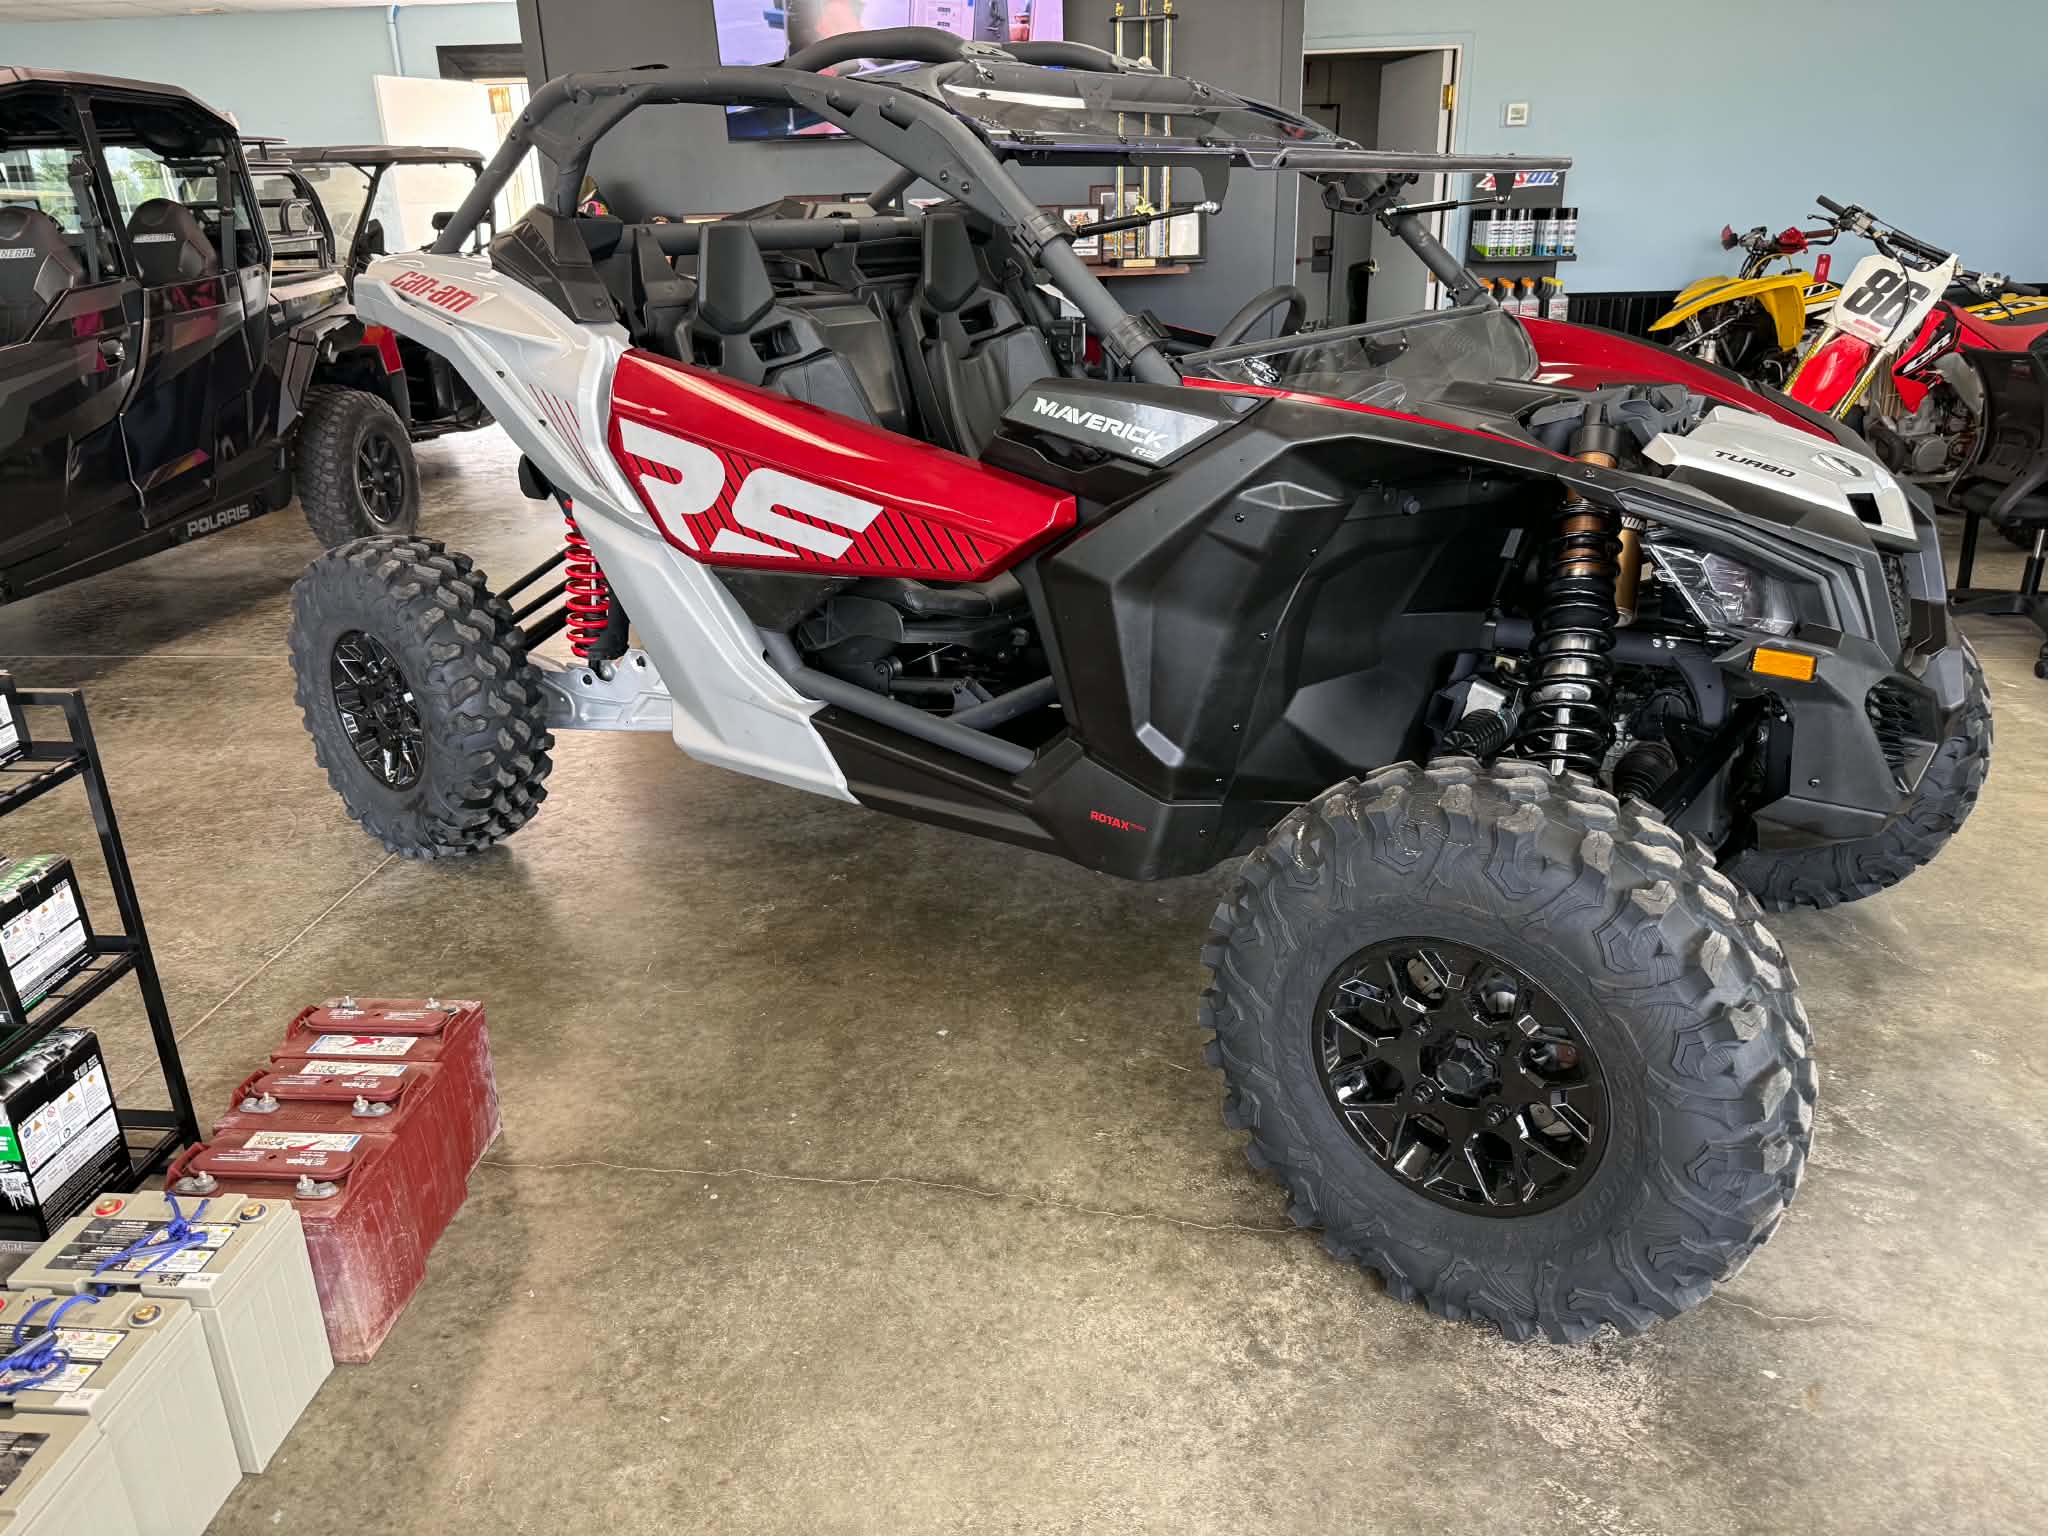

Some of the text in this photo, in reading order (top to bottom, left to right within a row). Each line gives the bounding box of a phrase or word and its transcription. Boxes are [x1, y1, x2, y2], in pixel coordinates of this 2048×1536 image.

[1476, 171, 1560, 191] ASOIL
[1843, 268, 1931, 328] 86
[1033, 396, 1169, 449] MAVERICK
[1131, 446, 1159, 460] RS
[1715, 450, 1797, 478] TURBO
[619, 416, 884, 560] RS
[187, 504, 250, 537] POLARIS
[1090, 810, 1130, 831] ROTAX
